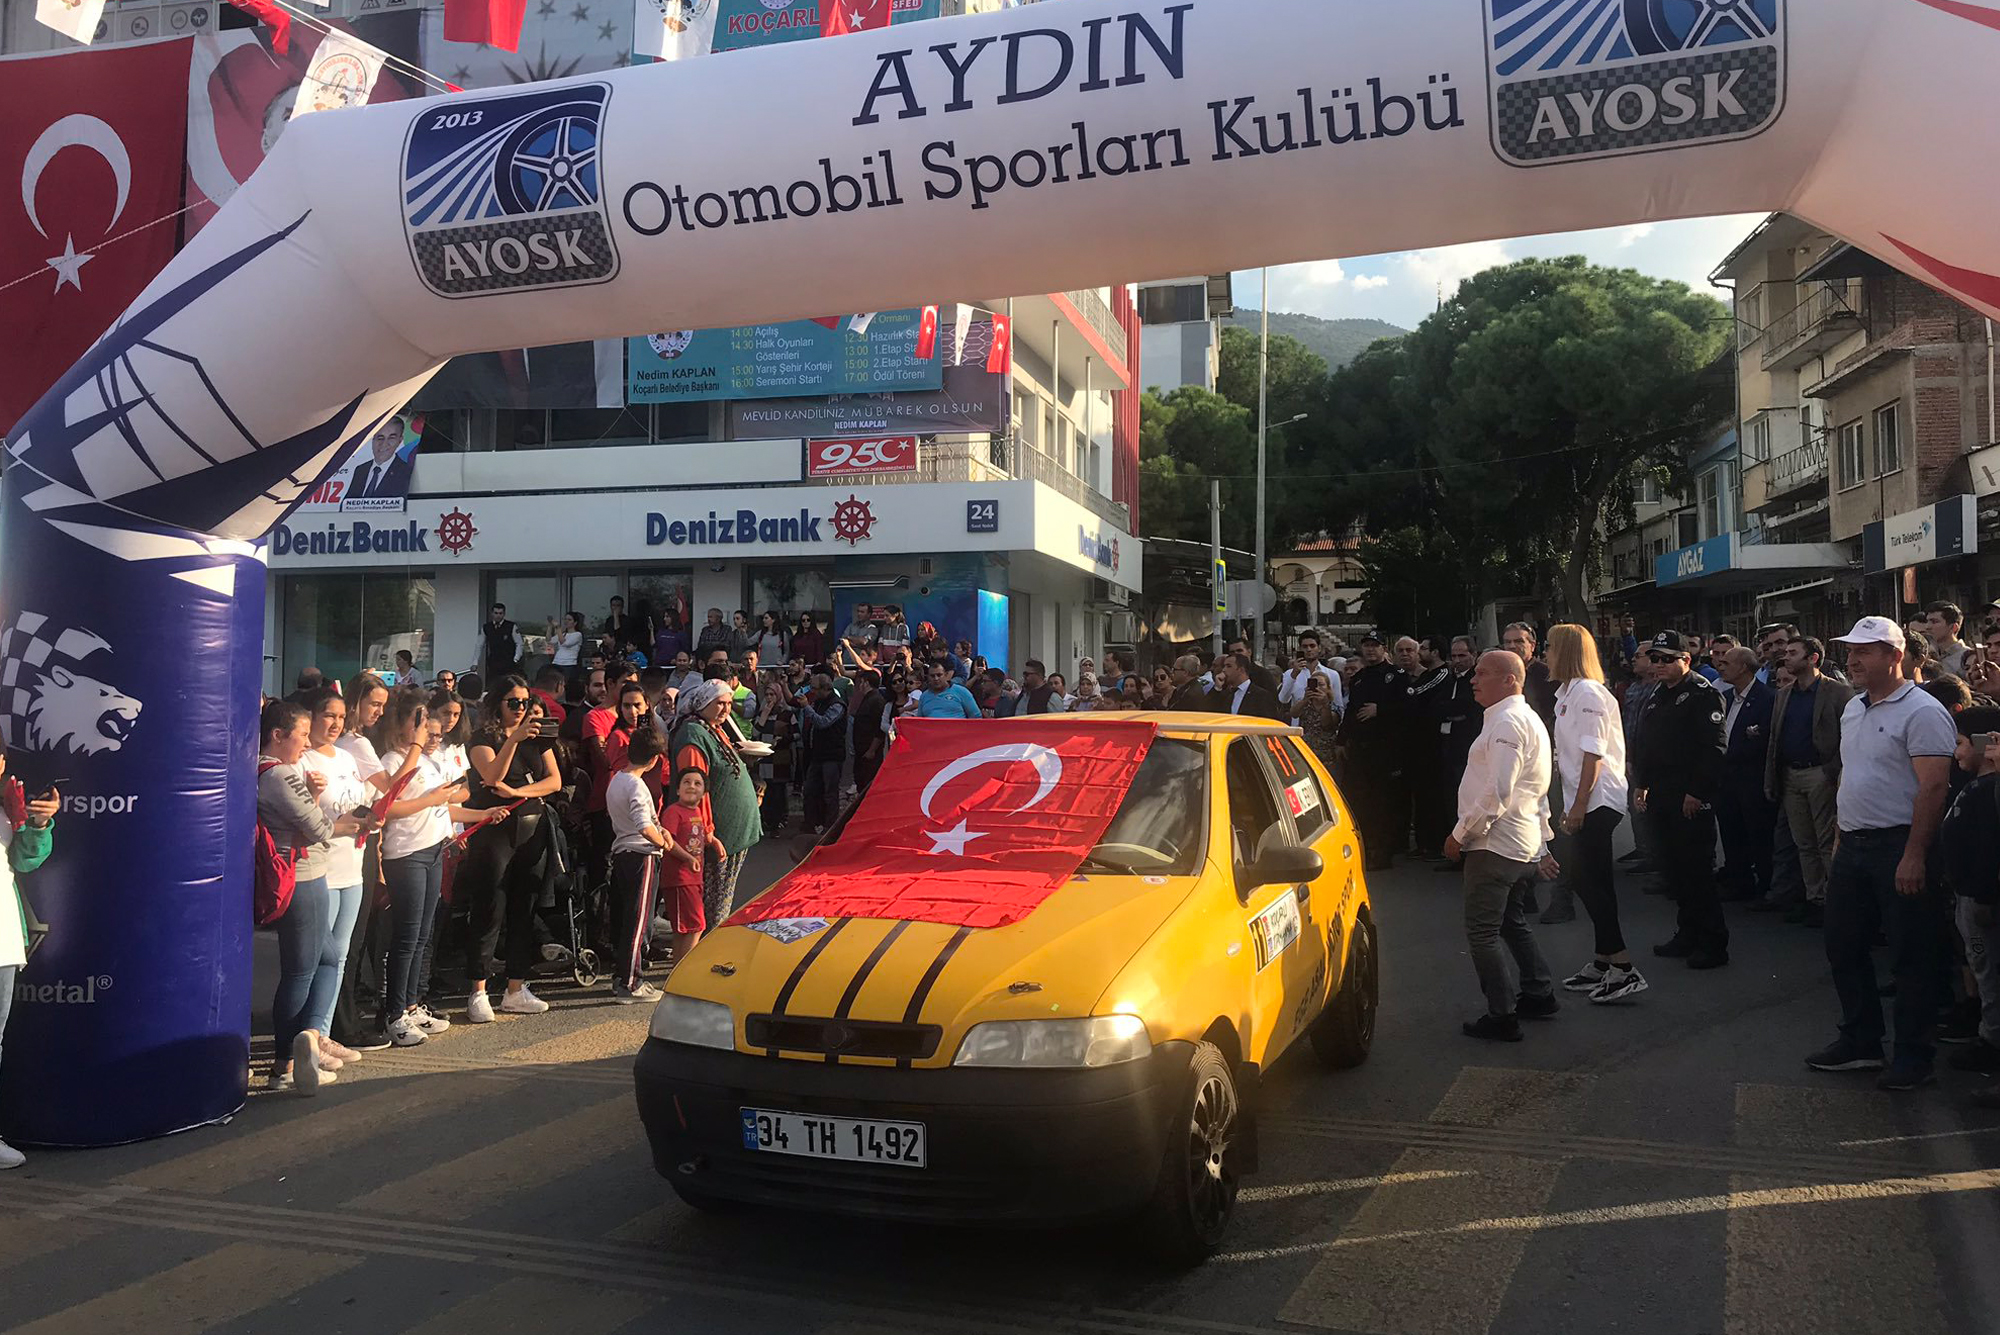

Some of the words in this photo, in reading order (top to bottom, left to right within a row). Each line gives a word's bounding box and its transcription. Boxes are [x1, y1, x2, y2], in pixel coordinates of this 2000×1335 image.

[727, 7, 822, 35] KOÇARL
[852, 3, 1194, 126] AYDIN
[1526, 68, 1749, 144] AYOSK
[430, 110, 483, 131] 2013
[622, 149, 903, 237] Otomobil
[920, 121, 1191, 210] Sporları
[1207, 72, 1464, 162] Kulübü
[442, 227, 595, 281] AYOSK
[755, 326, 779, 338] Açılış
[755, 340, 775, 349] Halk
[777, 337, 814, 349] Oyunları
[637, 370, 669, 380] Nedim
[672, 366, 716, 379] KAPLAN
[756, 363, 777, 375] Yarış
[779, 362, 802, 374] Şehir
[804, 360, 833, 372] Korteji
[897, 369, 925, 380] Töreni
[633, 384, 658, 396] Koçarlı
[659, 382, 690, 394] Belediye
[691, 381, 720, 393] Başkanı
[756, 376, 796, 387] Seremoni
[742, 408, 782, 421] MEVLİD
[784, 406, 845, 419] KANDİLİNİZ
[851, 404, 923, 417] MÜBAREK
[929, 402, 983, 414] OLSUN
[859, 419, 887, 428] KAPLAN
[970, 504, 994, 520] 24
[646, 508, 822, 546] DenizBank
[273, 520, 429, 555] DenizBank
[1901, 531, 1923, 545] Telekom
[1677, 546, 1704, 577] AYGAZ
[40, 794, 138, 819] rspor
[747, 1131, 757, 1142] TR
[757, 1115, 789, 1149] 34
[803, 1120, 836, 1154] TH
[852, 1124, 919, 1163] 1492
